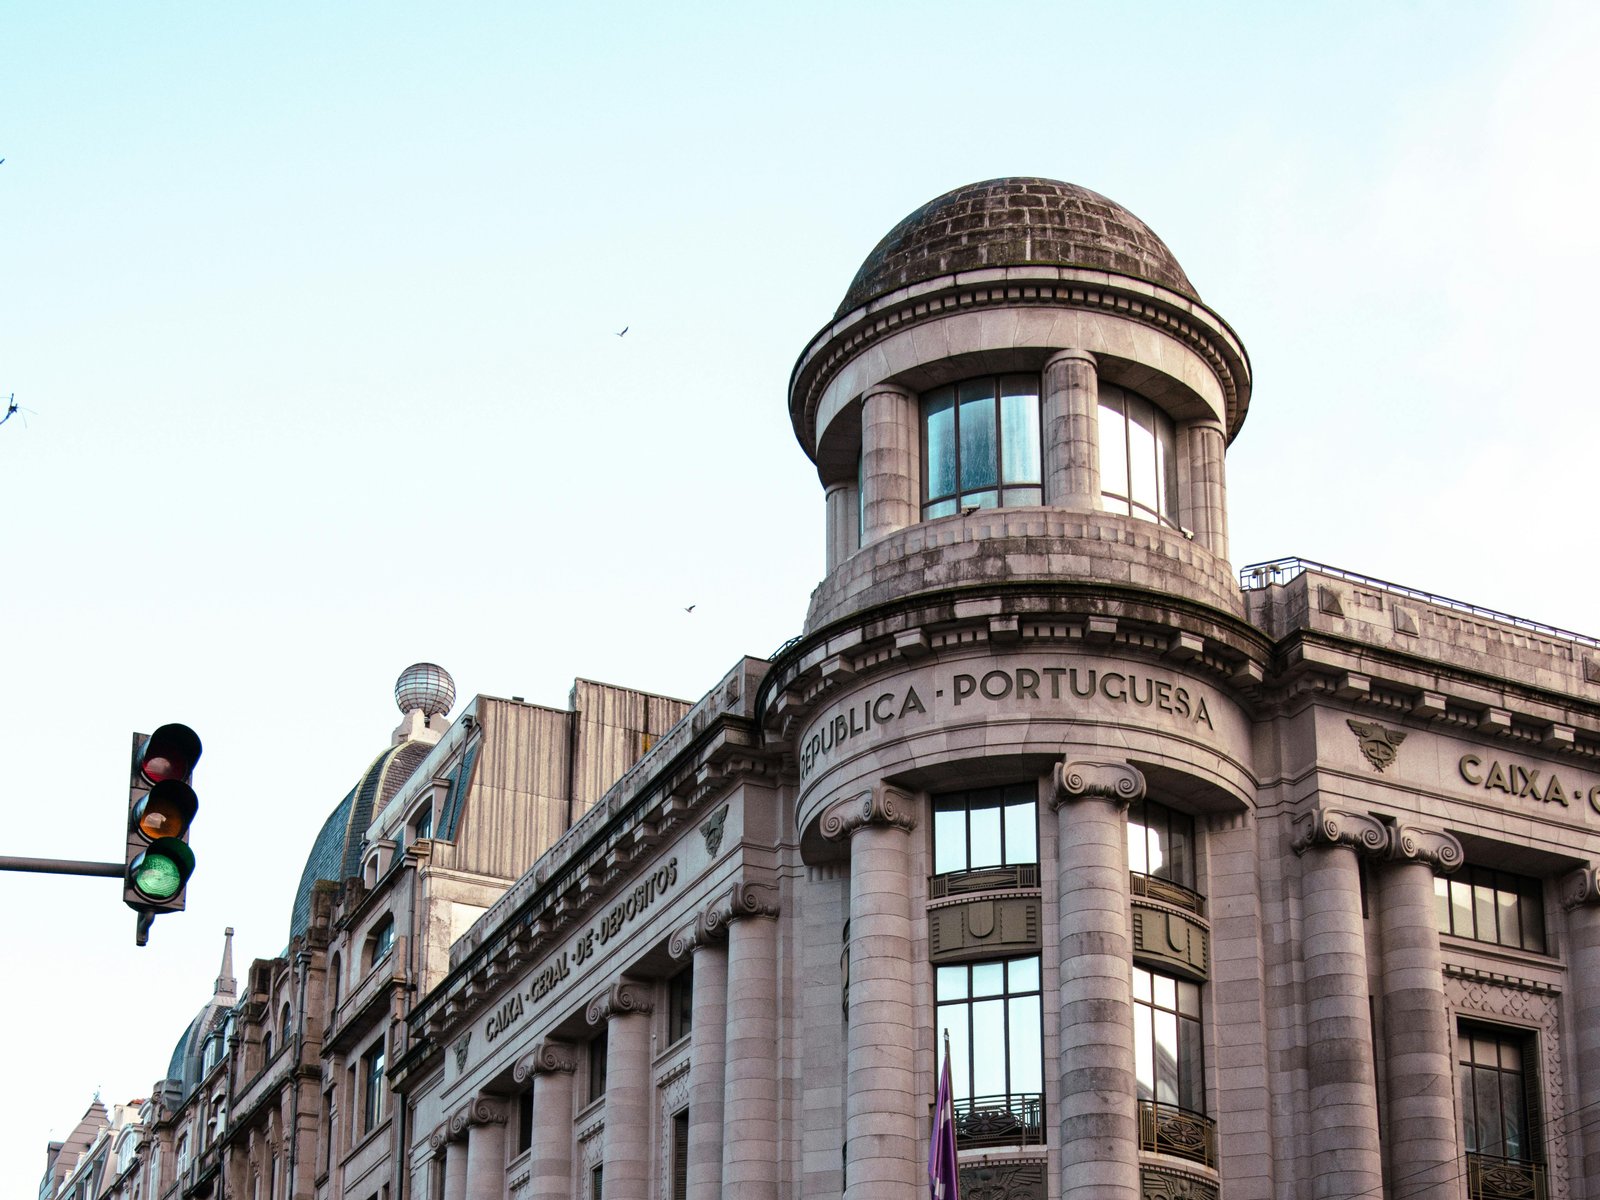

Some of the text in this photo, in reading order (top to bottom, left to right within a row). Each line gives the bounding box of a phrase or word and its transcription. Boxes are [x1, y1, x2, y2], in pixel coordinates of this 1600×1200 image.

[801, 667, 1214, 781] REPUBLICA PORTUGUESA
[1460, 754, 1569, 806] CAIXA
[485, 857, 679, 1042] CAIXA GERAL DE DEPOSITOS
